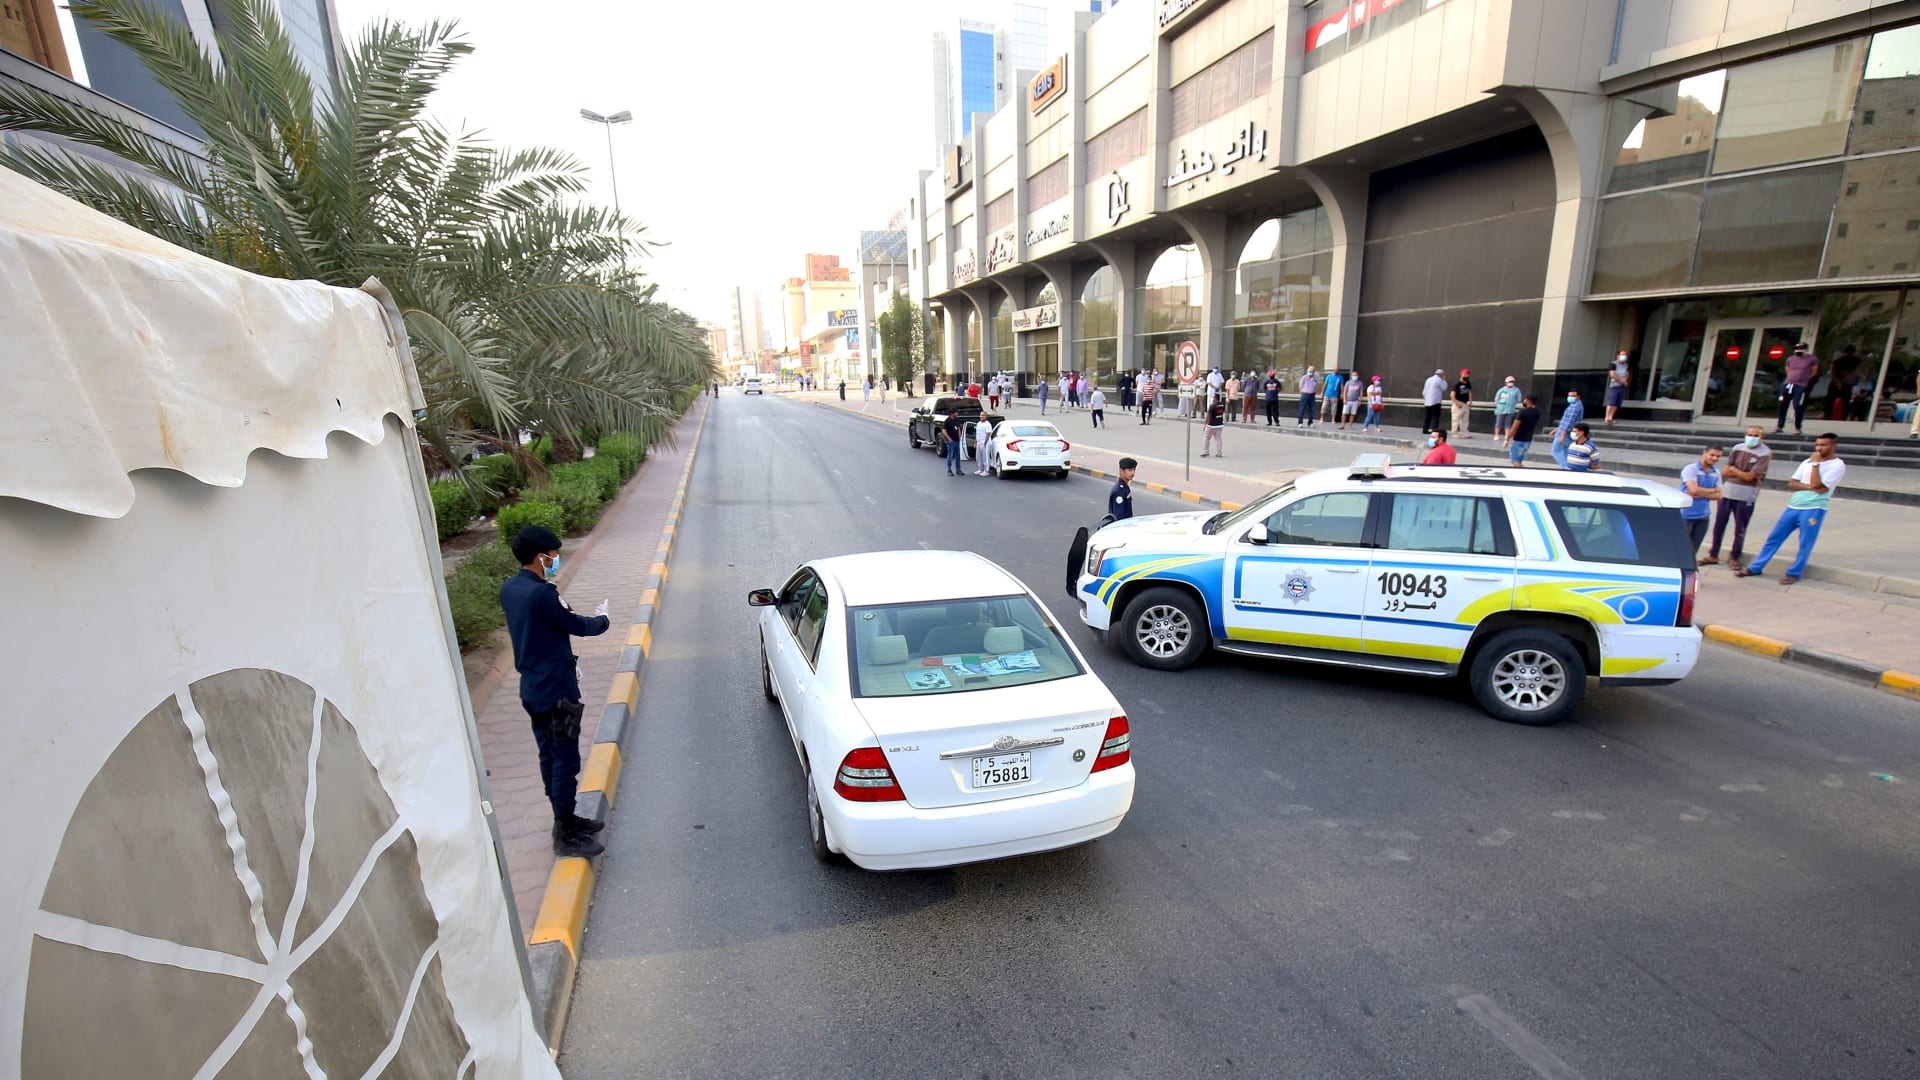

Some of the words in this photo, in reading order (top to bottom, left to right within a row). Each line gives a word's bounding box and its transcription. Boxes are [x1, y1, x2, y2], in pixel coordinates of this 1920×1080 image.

[1377, 571, 1448, 599] 10943
[1381, 598, 1437, 613] مرور
[988, 757, 995, 768] 5
[983, 765, 1029, 785] 75881
